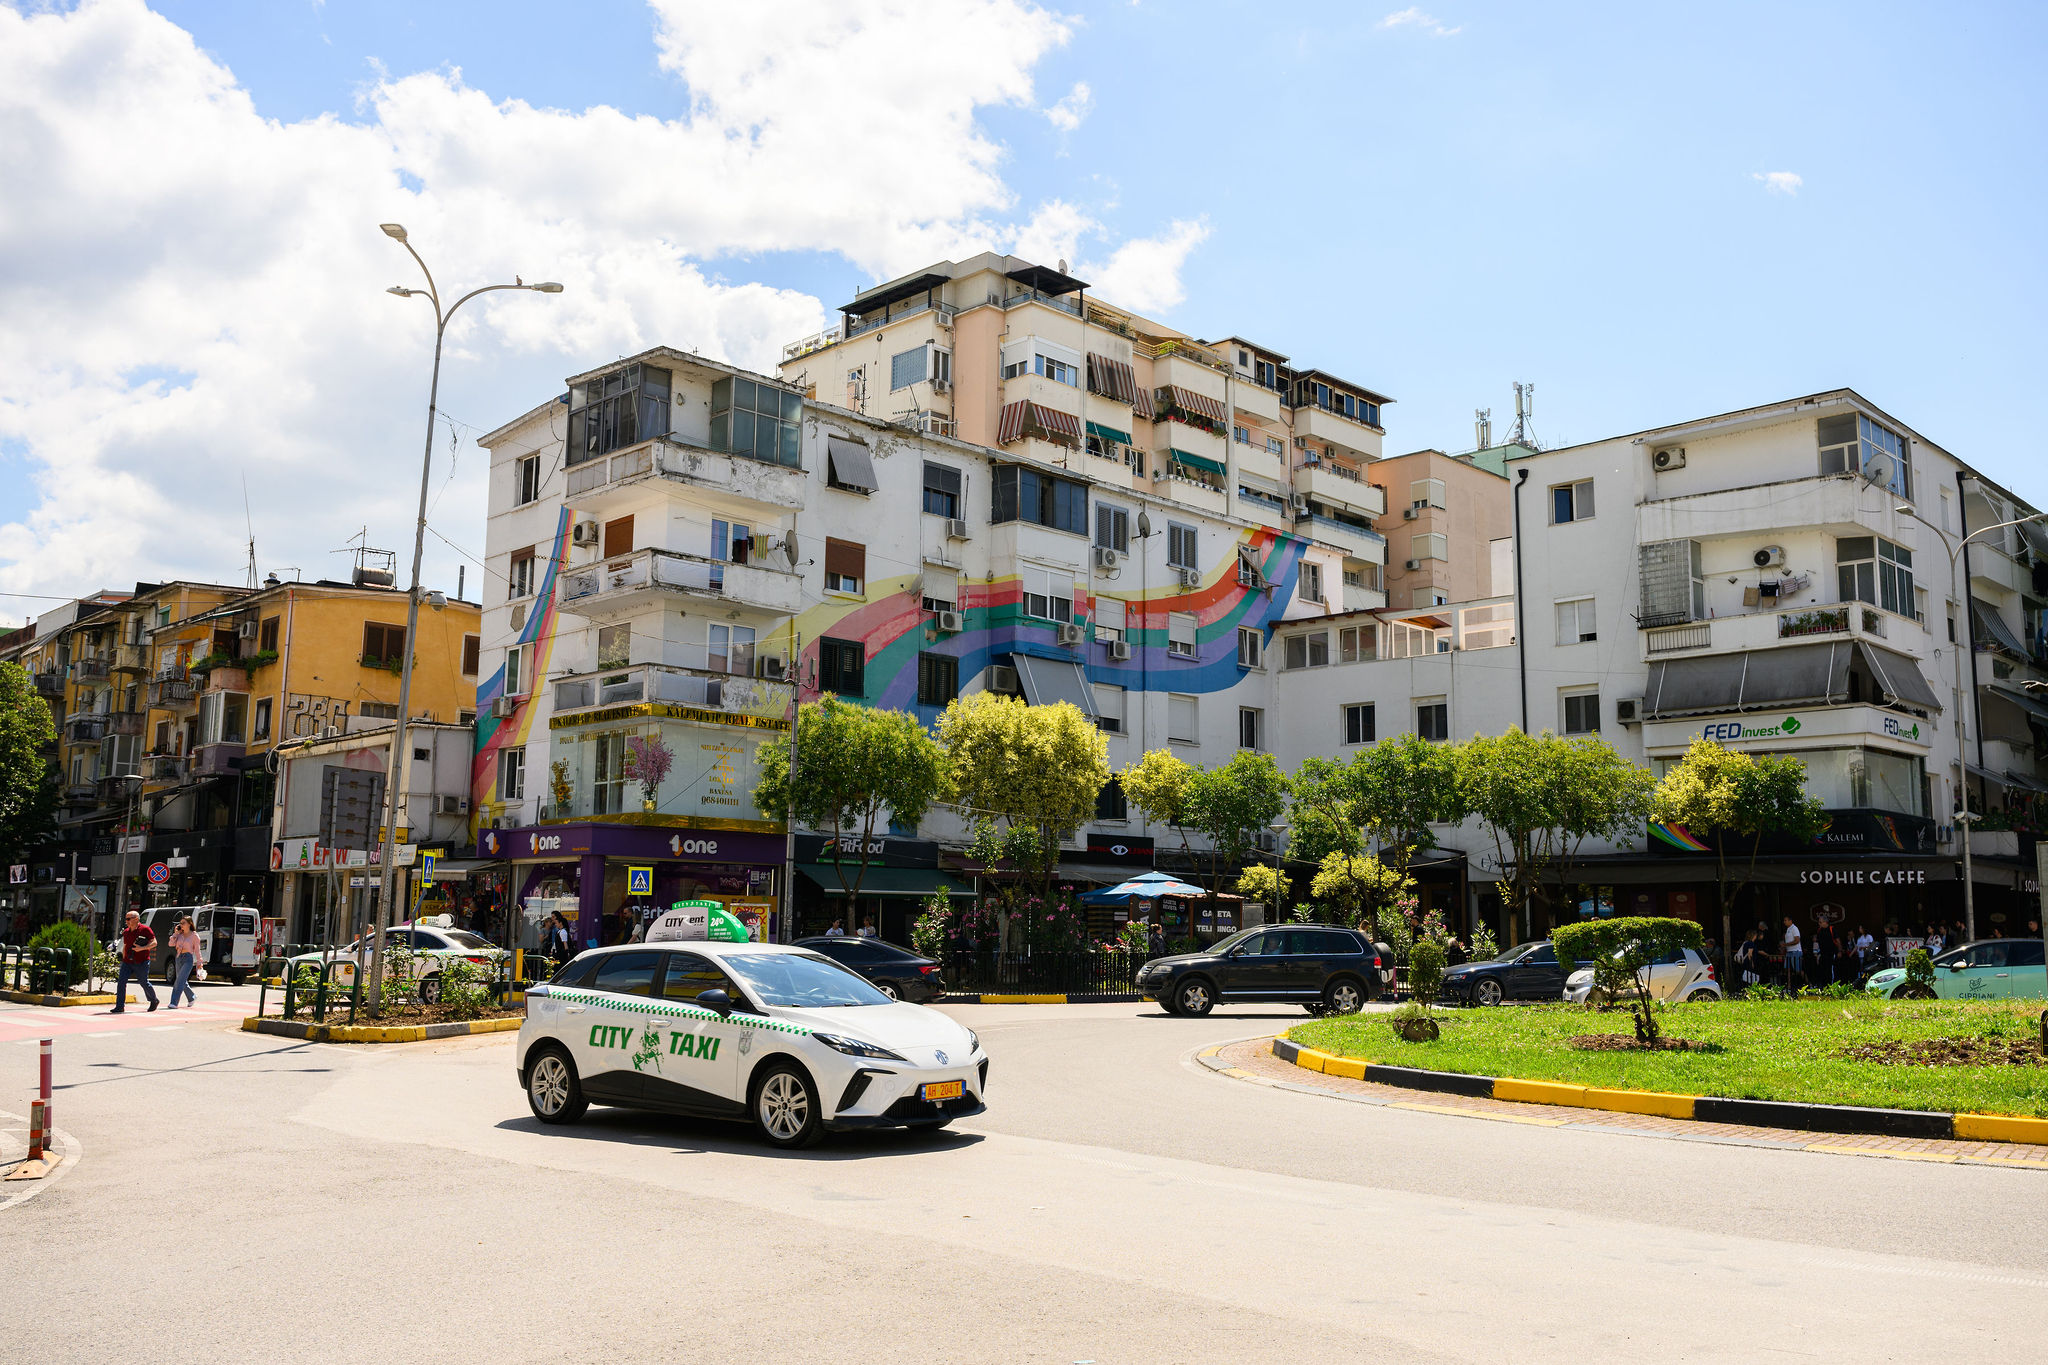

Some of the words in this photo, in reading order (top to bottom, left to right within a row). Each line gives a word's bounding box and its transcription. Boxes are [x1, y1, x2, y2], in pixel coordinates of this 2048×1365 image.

[666, 706, 703, 721] KALEMI
[1827, 833, 1864, 842] KALEMI
[836, 838, 885, 854] FitFod
[1800, 870, 1864, 884] SOPHIE
[1869, 869, 1925, 884] CAFFE
[1202, 910, 1232, 918] GAETA
[589, 1024, 634, 1049] CITY
[669, 1031, 721, 1061] TAXI
